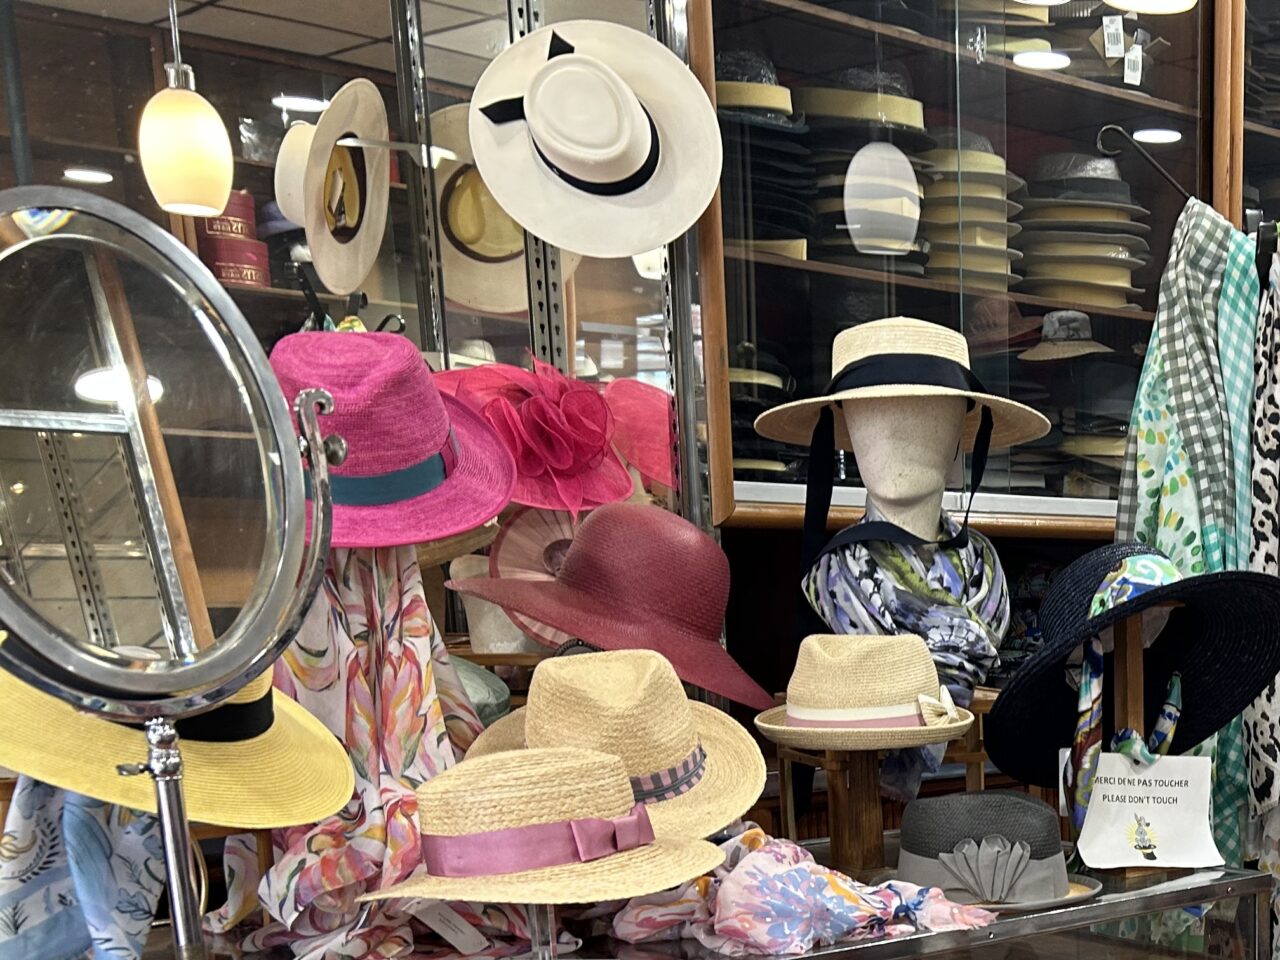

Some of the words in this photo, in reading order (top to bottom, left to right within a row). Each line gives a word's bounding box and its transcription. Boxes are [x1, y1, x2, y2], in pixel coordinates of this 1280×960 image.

[1094, 776, 1116, 786] MERCI
[1118, 777, 1126, 786] DE
[1127, 778, 1136, 787] NE
[1137, 779, 1153, 788] PAS
[1154, 779, 1189, 788] TOUCHER
[1102, 794, 1127, 804] PLEASE
[1128, 795, 1150, 804] DON'T
[1152, 796, 1178, 805] TOUCH
